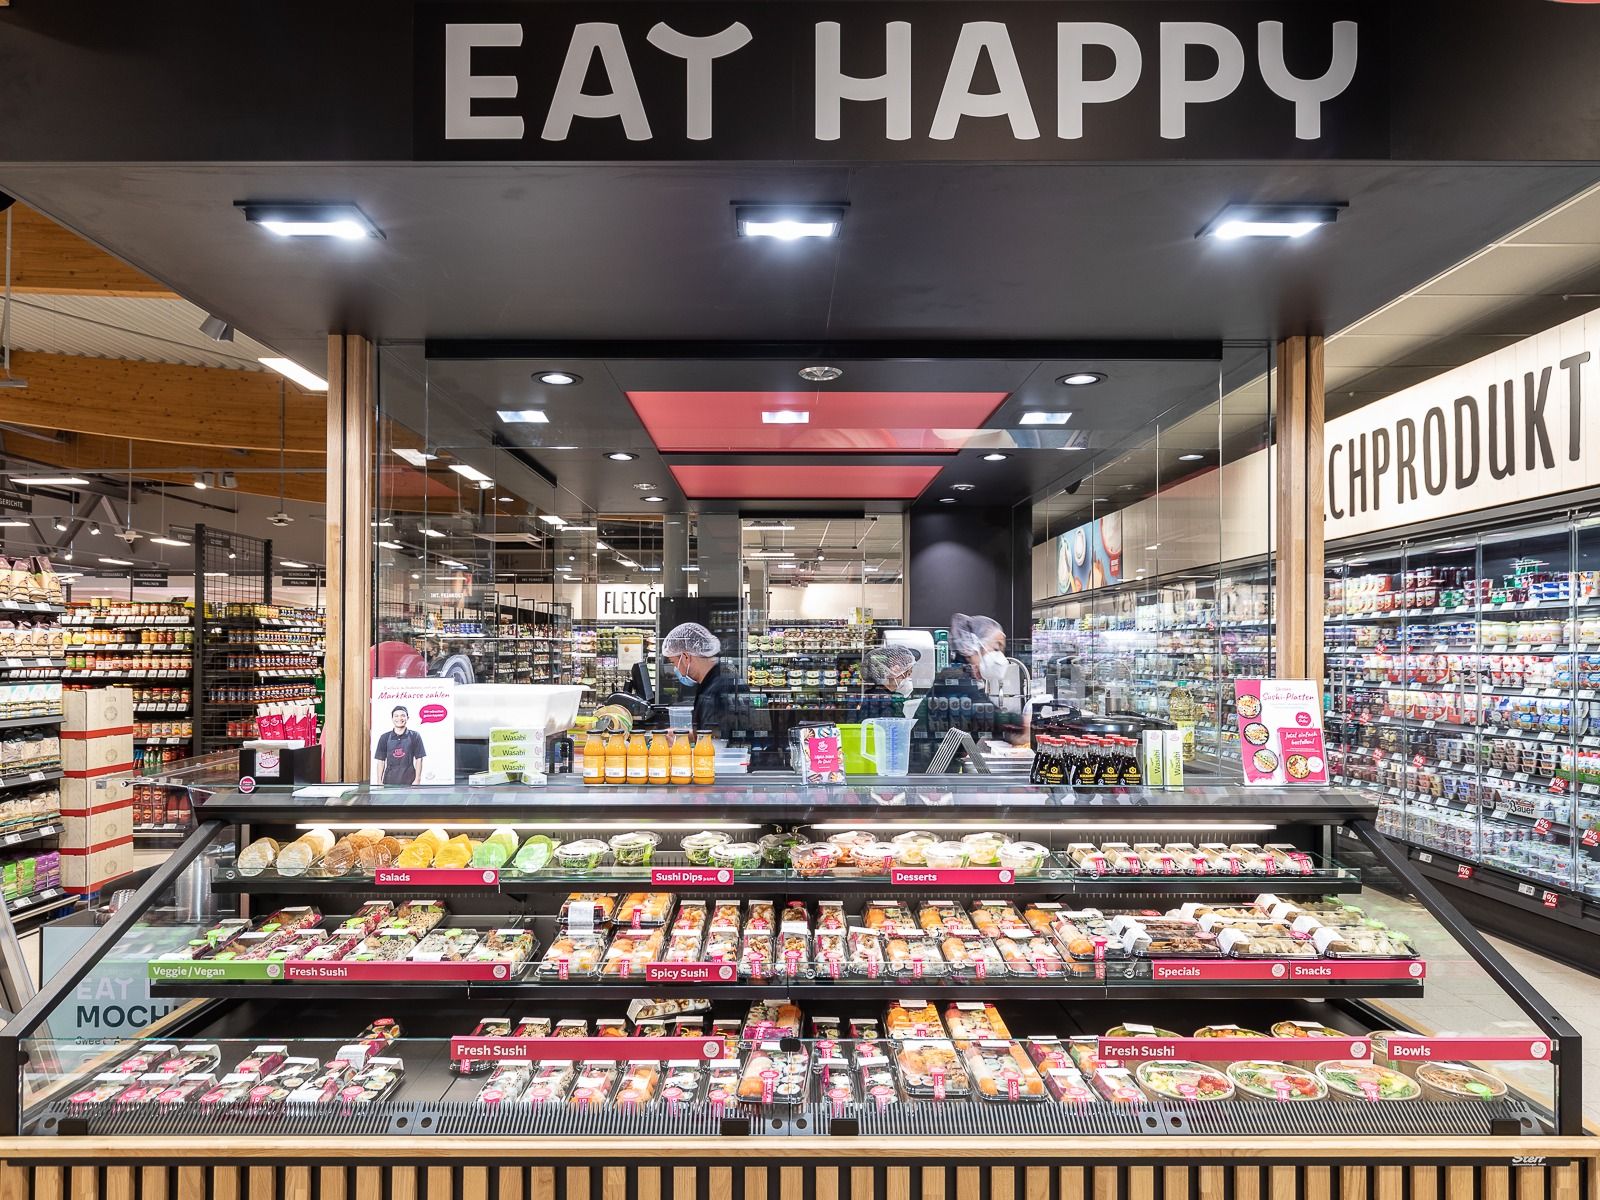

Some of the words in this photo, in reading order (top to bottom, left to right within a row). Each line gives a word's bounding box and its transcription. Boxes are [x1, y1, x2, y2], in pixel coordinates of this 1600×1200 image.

[444, 22, 753, 141] EAT
[814, 20, 1358, 141] HAPPY
[1324, 351, 1591, 521] CHPRODUKT
[604, 591, 663, 615] FLEISC
[1262, 692, 1314, 702] Sushi-Platten
[1173, 751, 1181, 776] Wasabi
[1509, 800, 1535, 815] Bauer
[379, 873, 411, 882] Salads
[655, 872, 681, 881] Sushi
[682, 872, 703, 883] Dips
[896, 873, 938, 882] Desserts
[152, 967, 187, 978] Veggie
[187, 967, 193, 978] /
[193, 967, 226, 978] Vegan
[289, 967, 318, 977] Fresh
[319, 967, 348, 977] Sushi
[651, 968, 679, 980] Spicy
[680, 968, 709, 978] Sushi
[1158, 967, 1201, 978] Specials
[1295, 966, 1332, 976] Snacks
[77, 976, 136, 1001] EAT
[76, 1004, 180, 1028] MOCH
[457, 1044, 491, 1056] Fresh
[493, 1044, 527, 1056] Sushi
[1104, 1045, 1139, 1057] Fresh
[1141, 1045, 1175, 1057] Sushi
[1393, 1045, 1431, 1057] Bowls
[1512, 1155, 1546, 1164] Sterr
